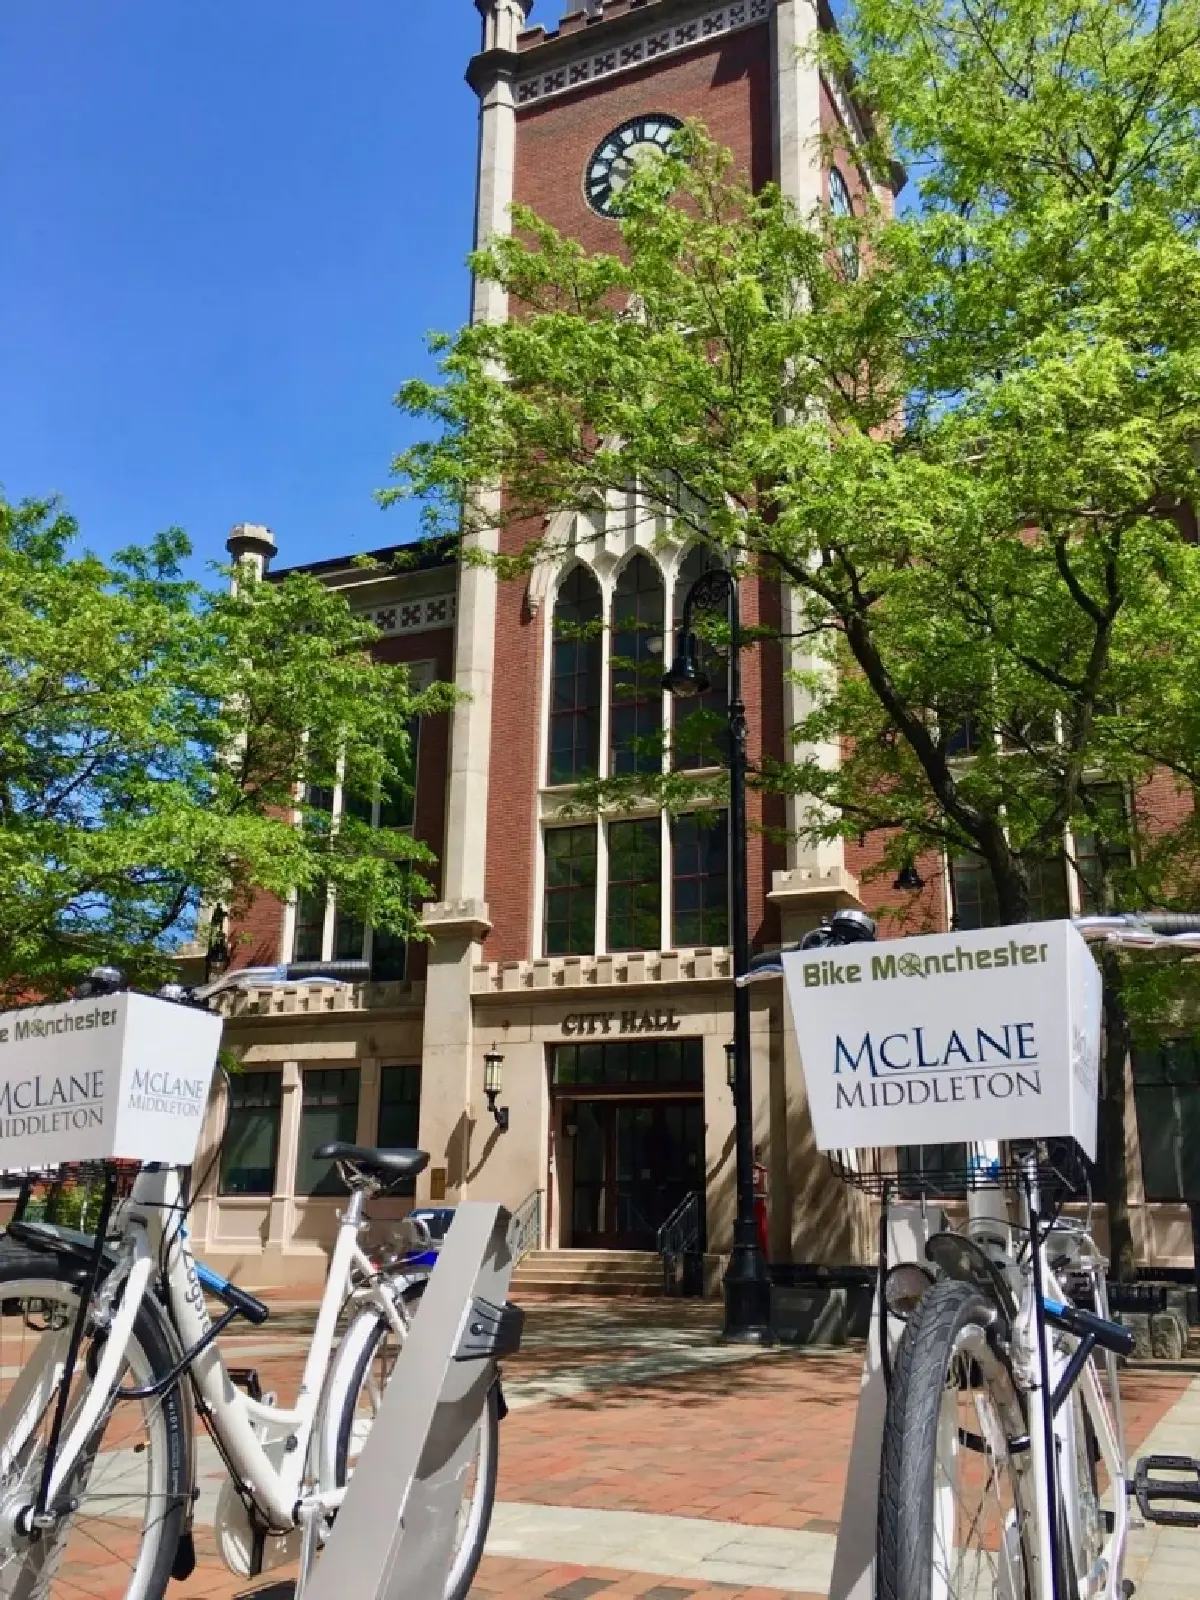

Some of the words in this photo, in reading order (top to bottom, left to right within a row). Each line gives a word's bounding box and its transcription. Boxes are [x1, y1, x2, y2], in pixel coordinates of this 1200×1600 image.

[802, 959, 862, 988] Bike
[871, 940, 1049, 981] Manchester
[561, 1011, 615, 1037] CITY
[619, 1007, 681, 1034] HALL
[127, 1094, 201, 1117] MIDDLETON
[835, 1069, 1043, 1109] MIDDLETON
